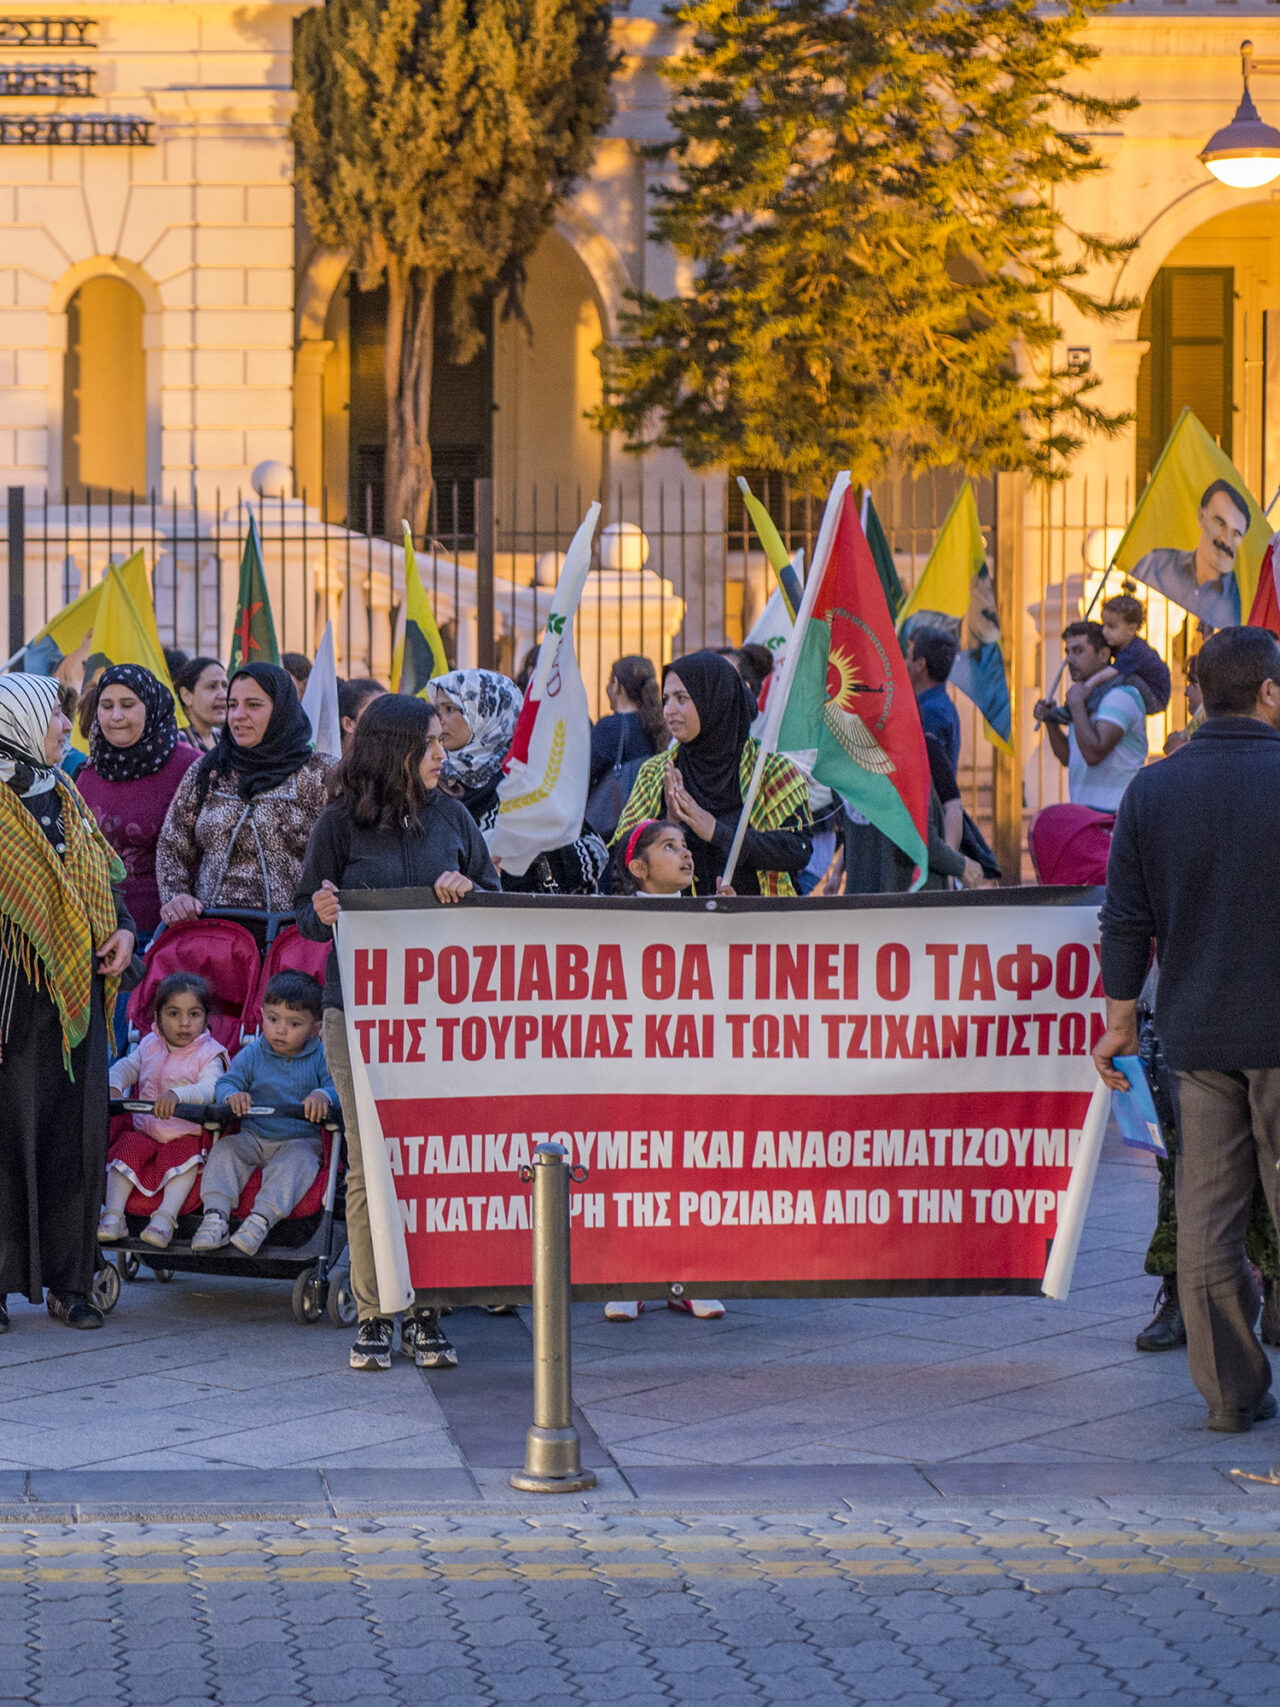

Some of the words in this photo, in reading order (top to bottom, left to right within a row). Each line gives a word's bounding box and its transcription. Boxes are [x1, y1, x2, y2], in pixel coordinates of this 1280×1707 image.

[355, 949, 387, 1005] Η
[404, 945, 627, 1004] ΡΟΖΙΑΒΑ
[642, 944, 713, 1000] ΘΑ
[729, 944, 858, 1000] ΓΙΝΕΙ
[876, 943, 910, 1001] Ο
[355, 1019, 425, 1063] ΤΗΣ
[437, 1015, 632, 1061] ΤΟΥΡΚΙΑΣ
[645, 1015, 714, 1058] ΚΑΙ
[726, 1014, 808, 1058] ΤΩΝ
[384, 1130, 674, 1176] ΑΤΑΔΙΚΑΟΥΜΕΝ
[682, 1129, 745, 1169] ΚΑΙ
[425, 1193, 605, 1233] ΚΑΤΑΛΗ
[612, 1191, 671, 1228] ΤΗΣ
[679, 1189, 817, 1227] ΡΟΖΙΑΒΑ
[822, 1189, 890, 1225] ΑΠΟ
[897, 1189, 964, 1225] ΤΗΝ
